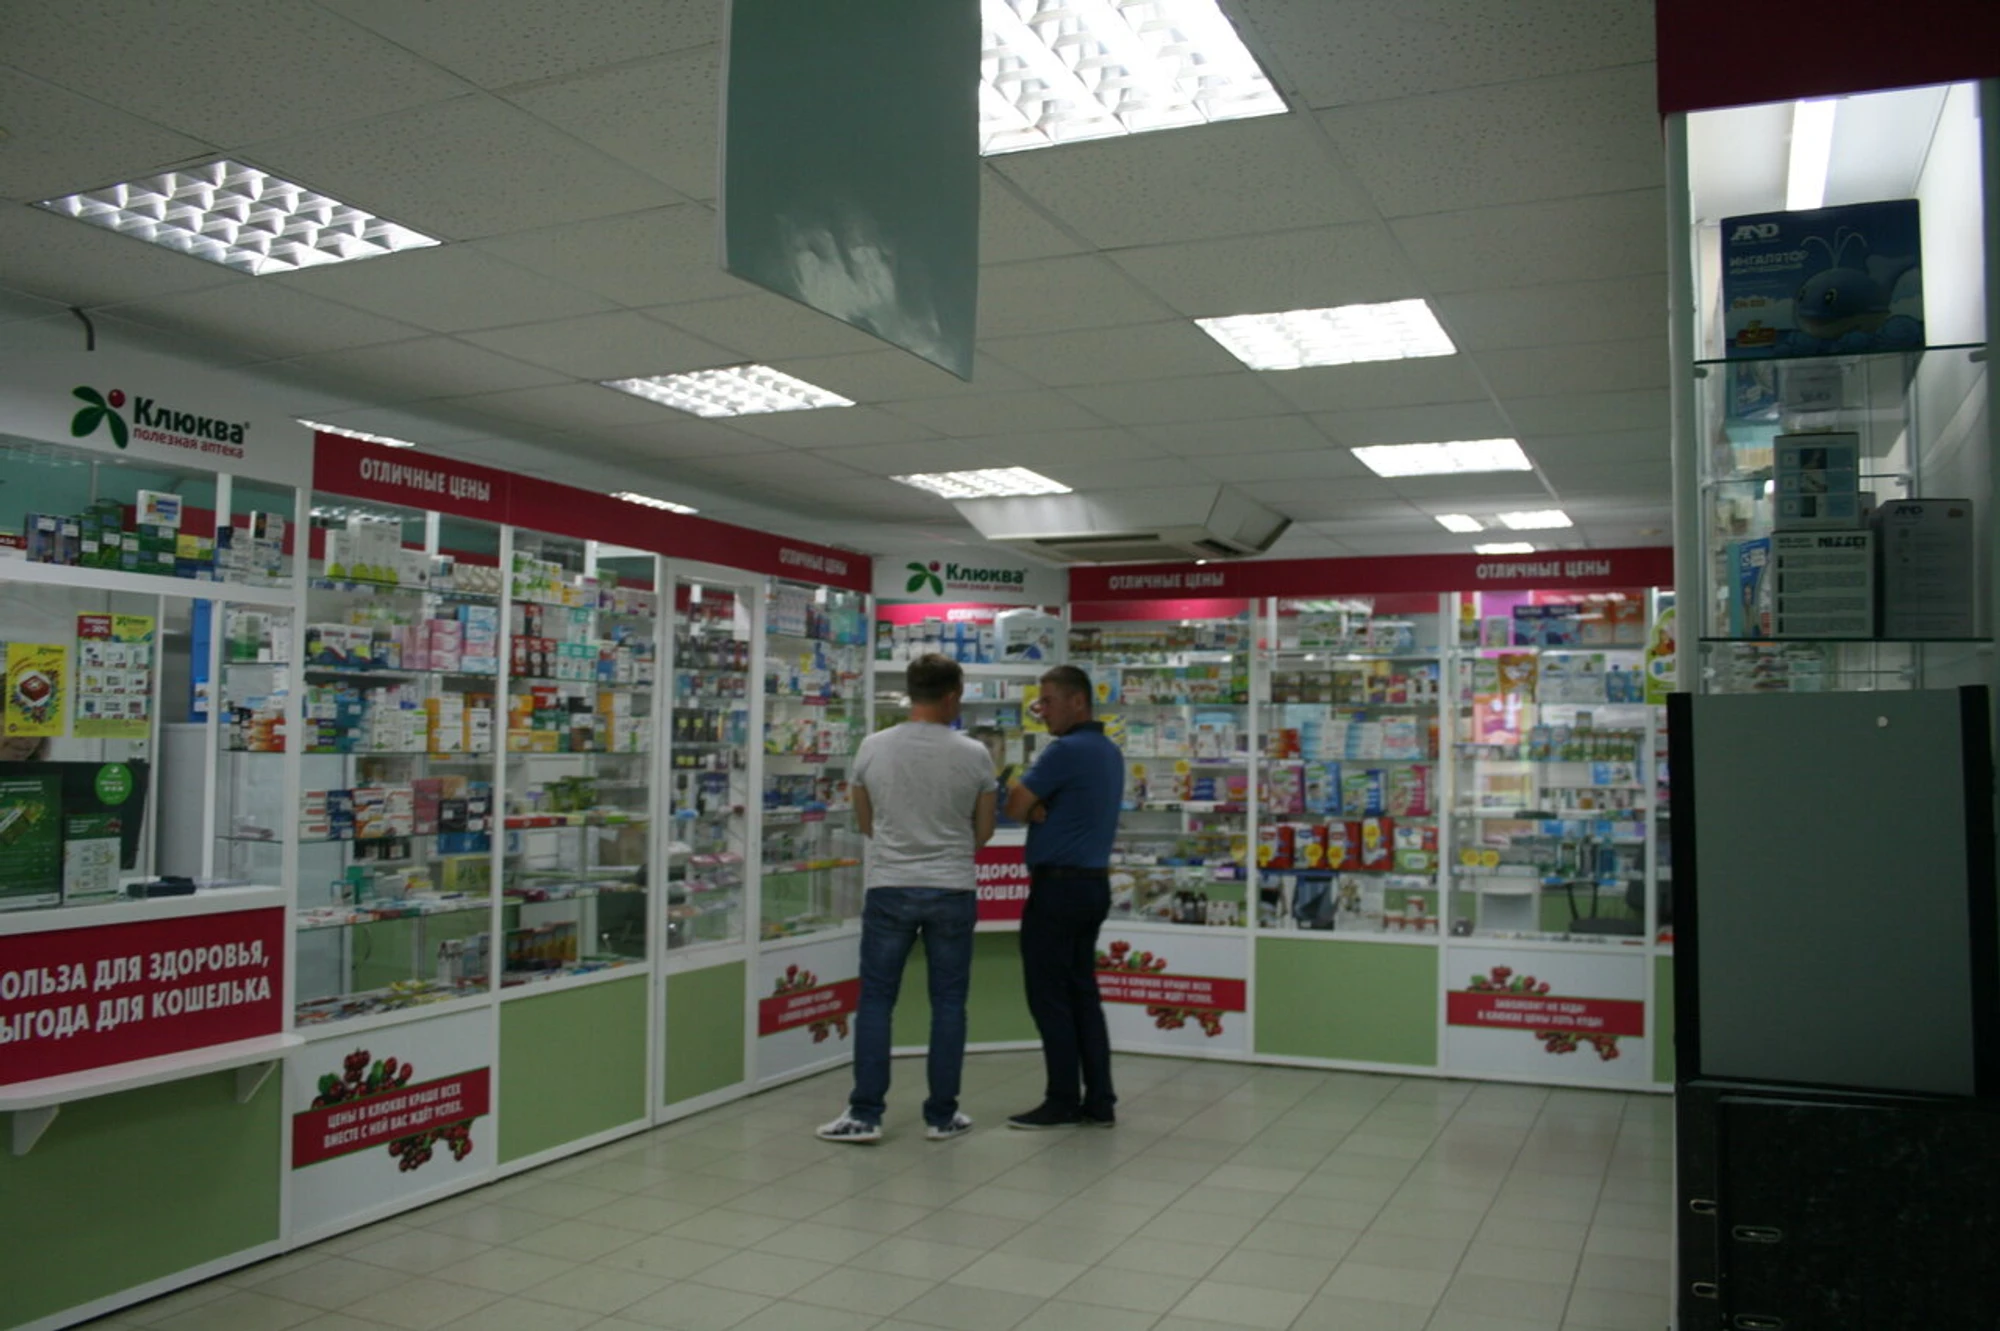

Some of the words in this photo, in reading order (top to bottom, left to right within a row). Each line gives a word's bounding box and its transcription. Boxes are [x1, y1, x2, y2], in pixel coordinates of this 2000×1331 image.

[134, 396, 244, 445] Клюква
[134, 428, 199, 450] полезная
[200, 441, 244, 459] аптека
[360, 457, 446, 493] ОТЛИЧНЫЕ
[449, 475, 491, 502] ЦЕНЫ
[946, 563, 1024, 584] Клюква
[1108, 573, 1181, 590] ОТЛИЧНЫЕ
[1184, 572, 1224, 590] ЦЕНЫ
[1475, 561, 1560, 579] ОТЛИЧНЫЕ
[1564, 560, 1611, 579] ЦЕНЫ
[0, 963, 88, 1001] ОЛЬЗА
[92, 955, 142, 992] ДЛЯ
[149, 939, 270, 983] ЗДОРОВЬЯ,
[0, 1003, 91, 1044] ЫГОДА
[95, 994, 144, 1033] ДЛЯ
[152, 976, 272, 1019] КОШЕЛЬКА
[327, 1107, 357, 1129] ЦЕНЫ
[359, 1106, 366, 1120] В
[368, 1096, 407, 1117] КЛЮКВЕ
[360, 1124, 367, 1139] С
[390, 1113, 409, 1131] ВАС
